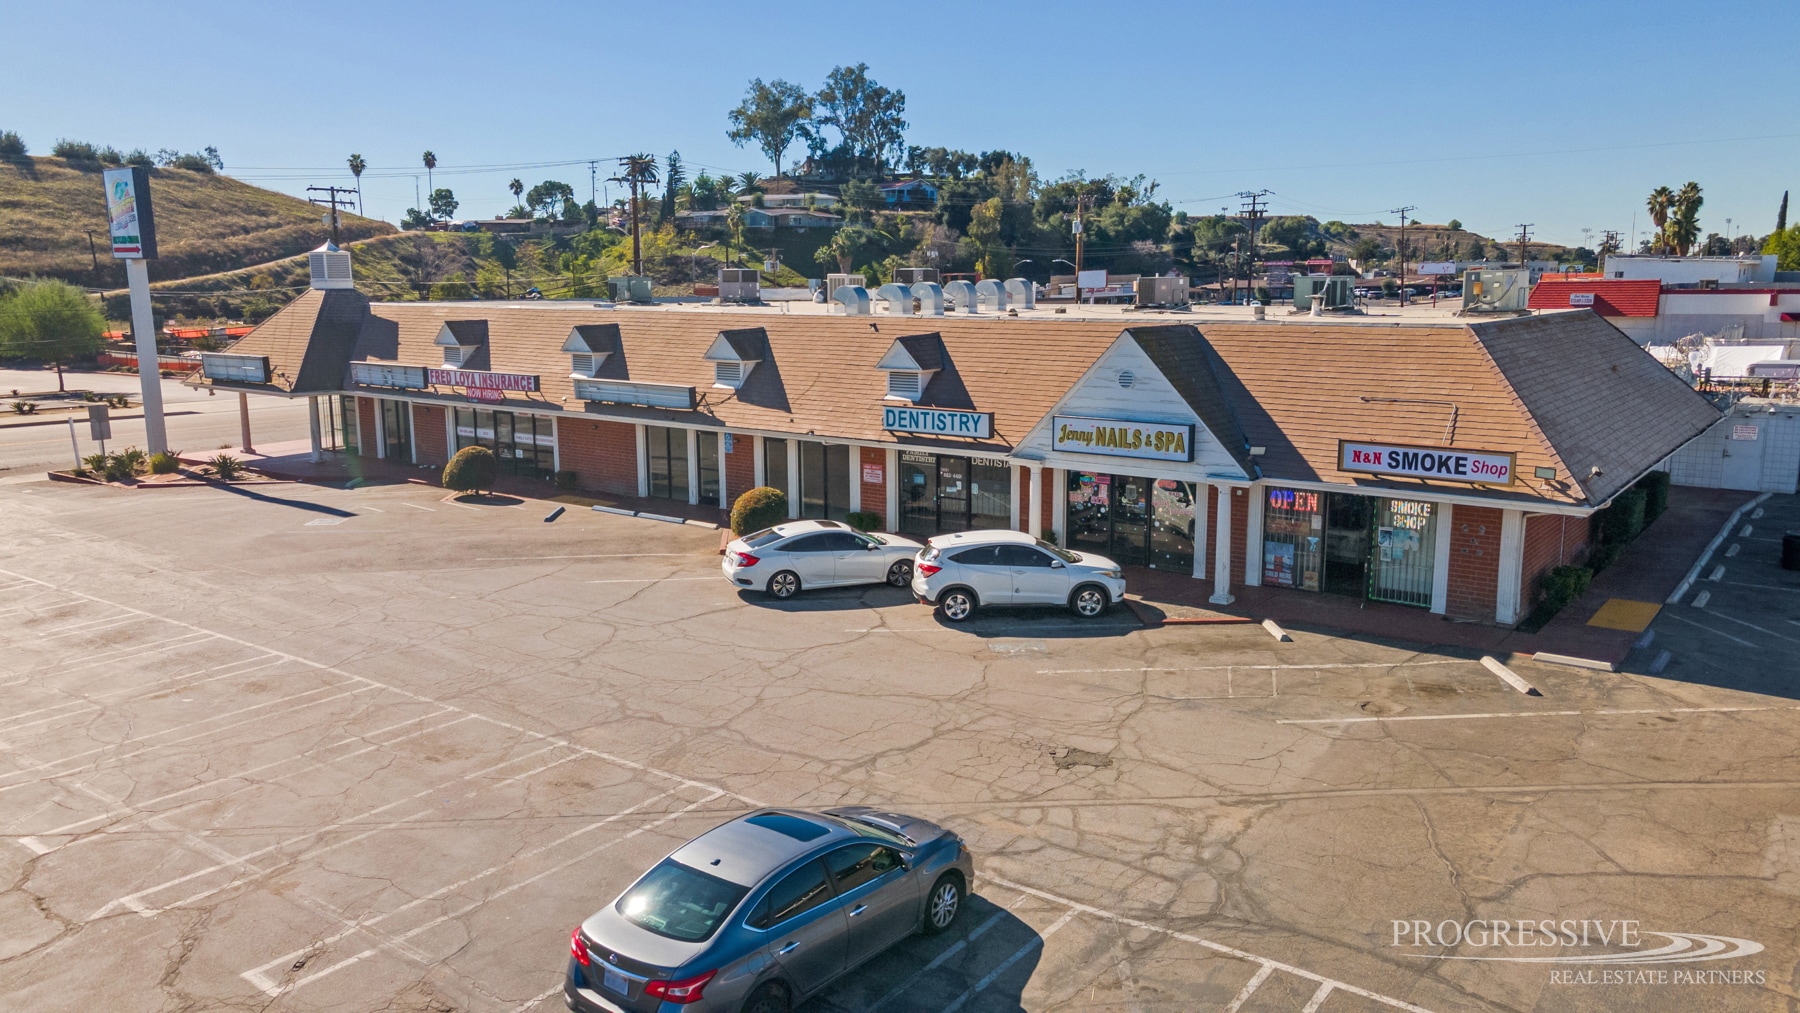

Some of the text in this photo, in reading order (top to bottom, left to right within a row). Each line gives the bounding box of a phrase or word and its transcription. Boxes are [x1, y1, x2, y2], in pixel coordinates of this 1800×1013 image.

[429, 370, 533, 391] FRED LOYA INSURANCE
[467, 388, 502, 400] NOW HIRING
[885, 409, 982, 433] DENTISTRY
[1058, 423, 1186, 454] Jenny NAILS & SPA
[902, 453, 936, 464] DENTISTRY
[971, 457, 1012, 468] DENTISTA
[1352, 450, 1508, 479] N&N SMOKE Shop
[1270, 489, 1318, 513] OPEN
[1390, 500, 1431, 517] SMOKE
[1393, 514, 1426, 530] SHOP
[1265, 570, 1292, 579] SOLD HERE
